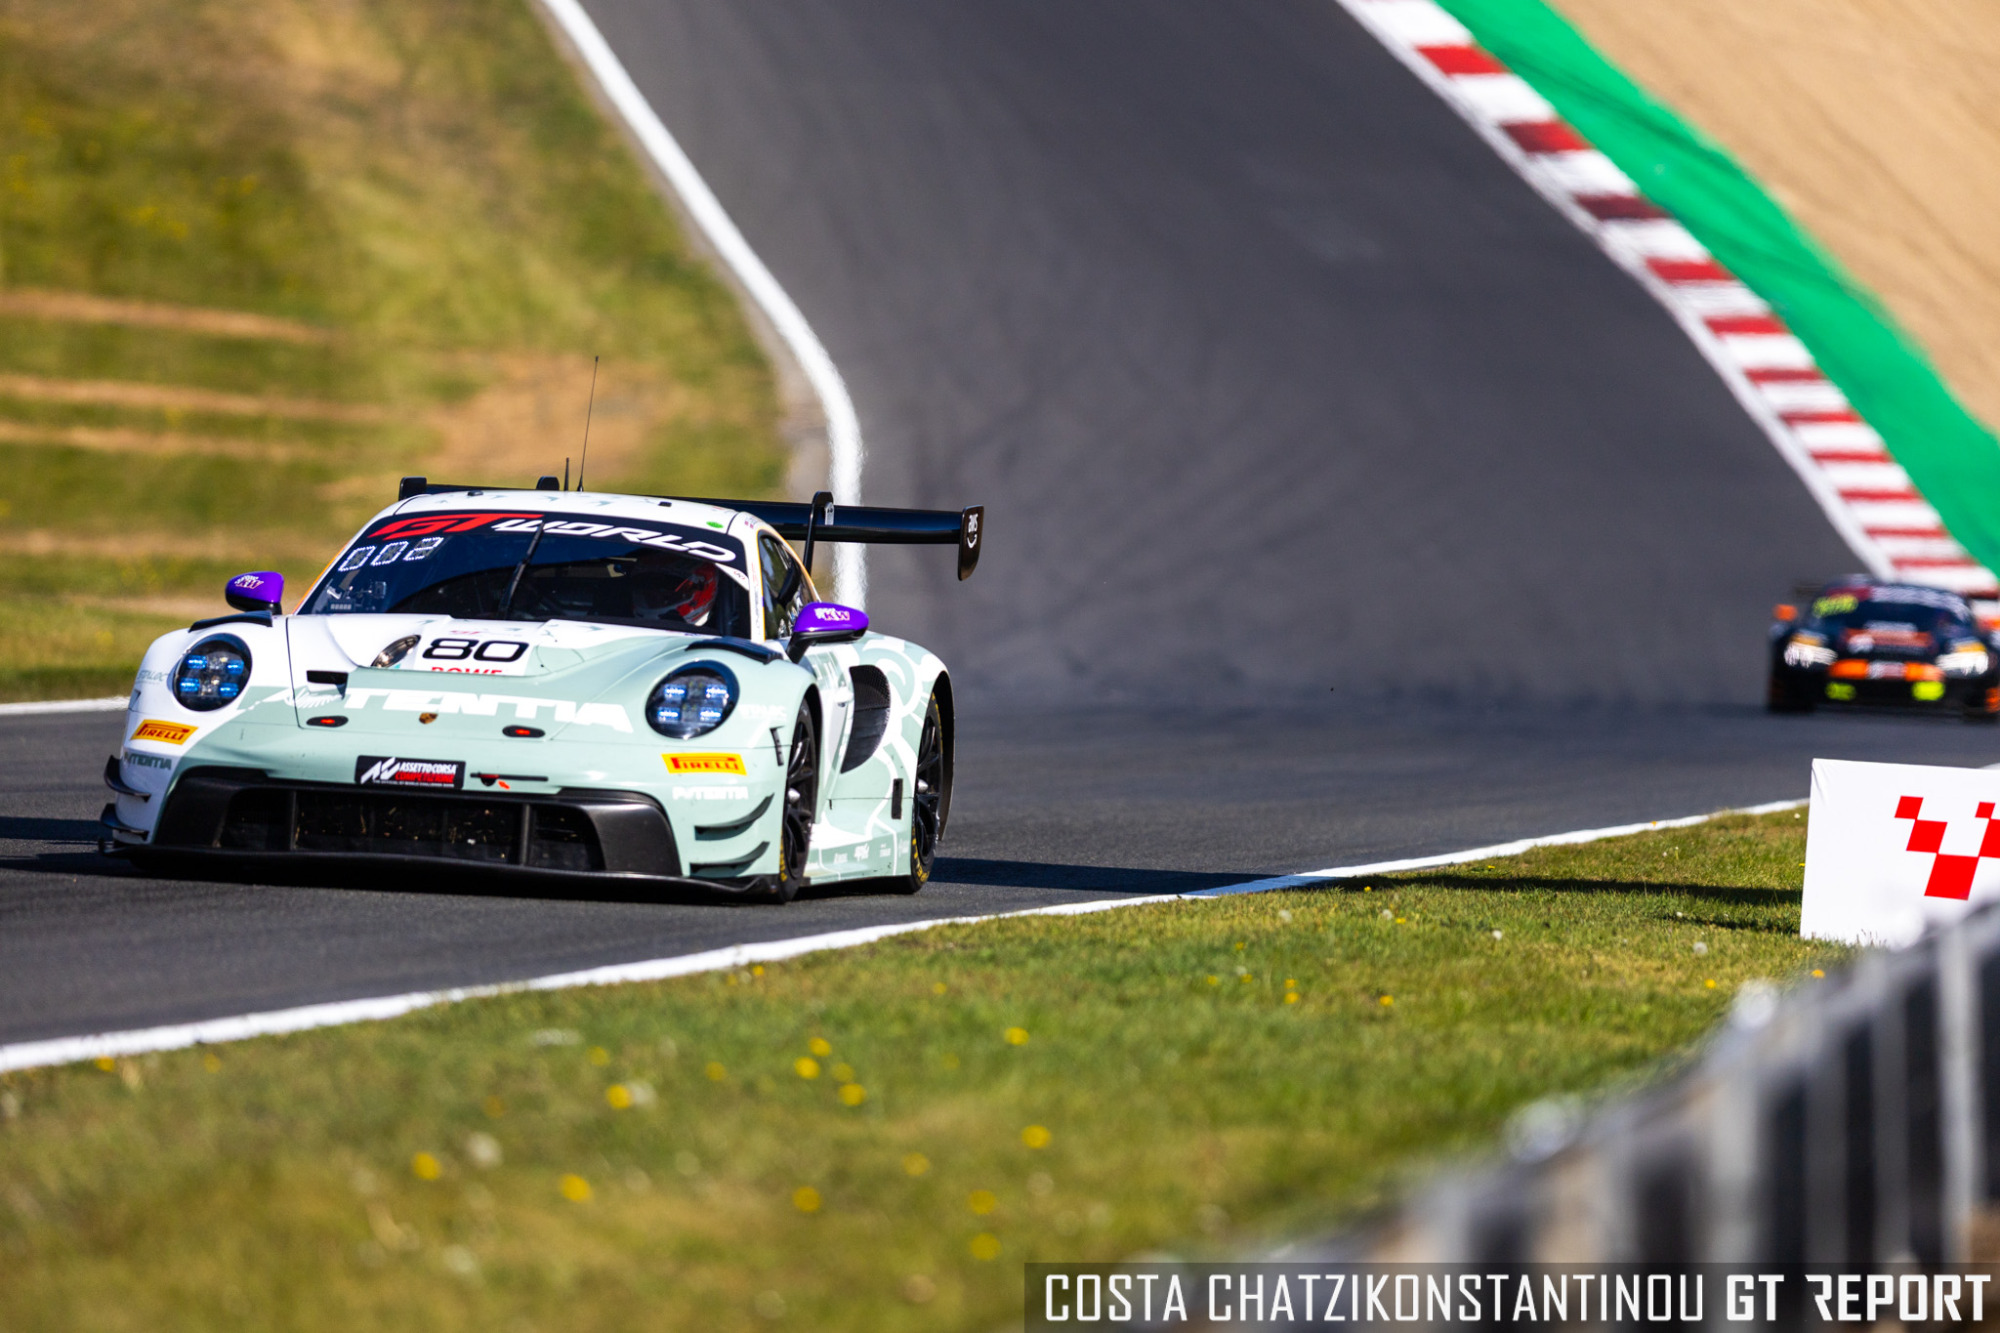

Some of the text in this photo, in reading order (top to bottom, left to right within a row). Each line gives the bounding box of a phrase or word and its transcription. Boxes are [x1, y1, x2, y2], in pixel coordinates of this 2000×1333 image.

[491, 518, 737, 562] WORLD
[422, 637, 530, 663] 80
[136, 722, 191, 742] PIRELLI
[670, 756, 740, 771] PIRELLI
